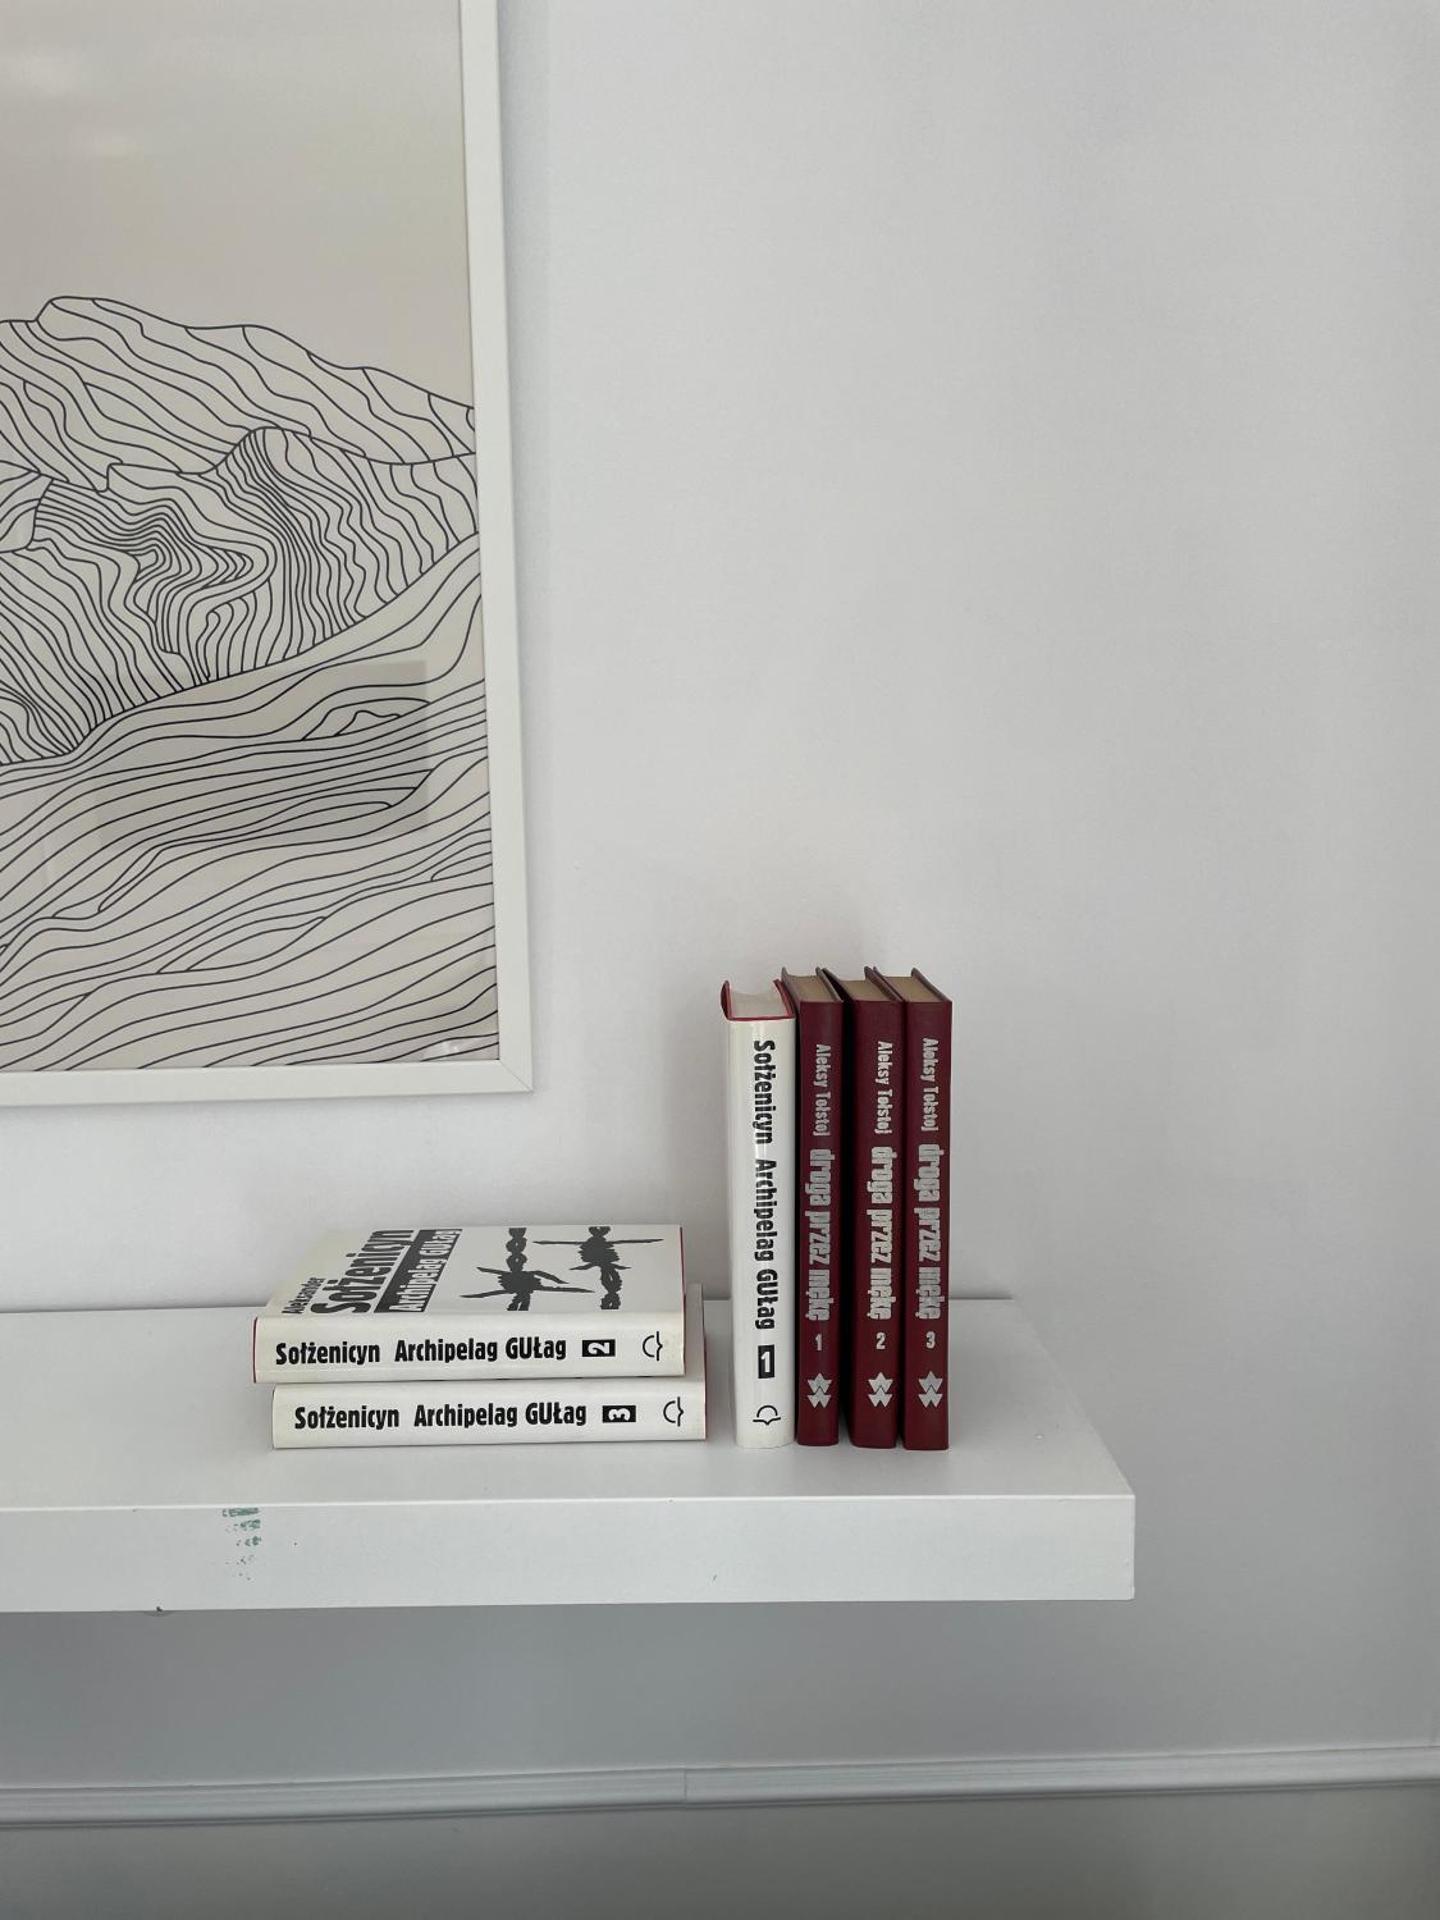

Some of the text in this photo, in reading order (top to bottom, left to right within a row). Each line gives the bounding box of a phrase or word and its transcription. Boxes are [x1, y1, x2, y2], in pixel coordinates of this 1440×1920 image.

[752, 1039, 779, 1374] Sołżenicyn Archipelag GUŁag 1
[804, 1043, 836, 1352] Aleksy Tołstoj droga przez mękę 1
[866, 1040, 898, 1350] Aleksy Tołstoj droga przez mękę 2
[913, 1037, 946, 1349] Aleksy Tołstoj droga przez mękę 3
[281, 1276, 326, 1314] Aleksander
[310, 1229, 415, 1314] Sołżenicyn
[388, 1257, 449, 1312] Archipelag
[275, 1335, 611, 1366] Sołżenicyn Archipelag GUŁag 2
[294, 1401, 632, 1430] Sołżenicyn Archipelag GUŁag 3
